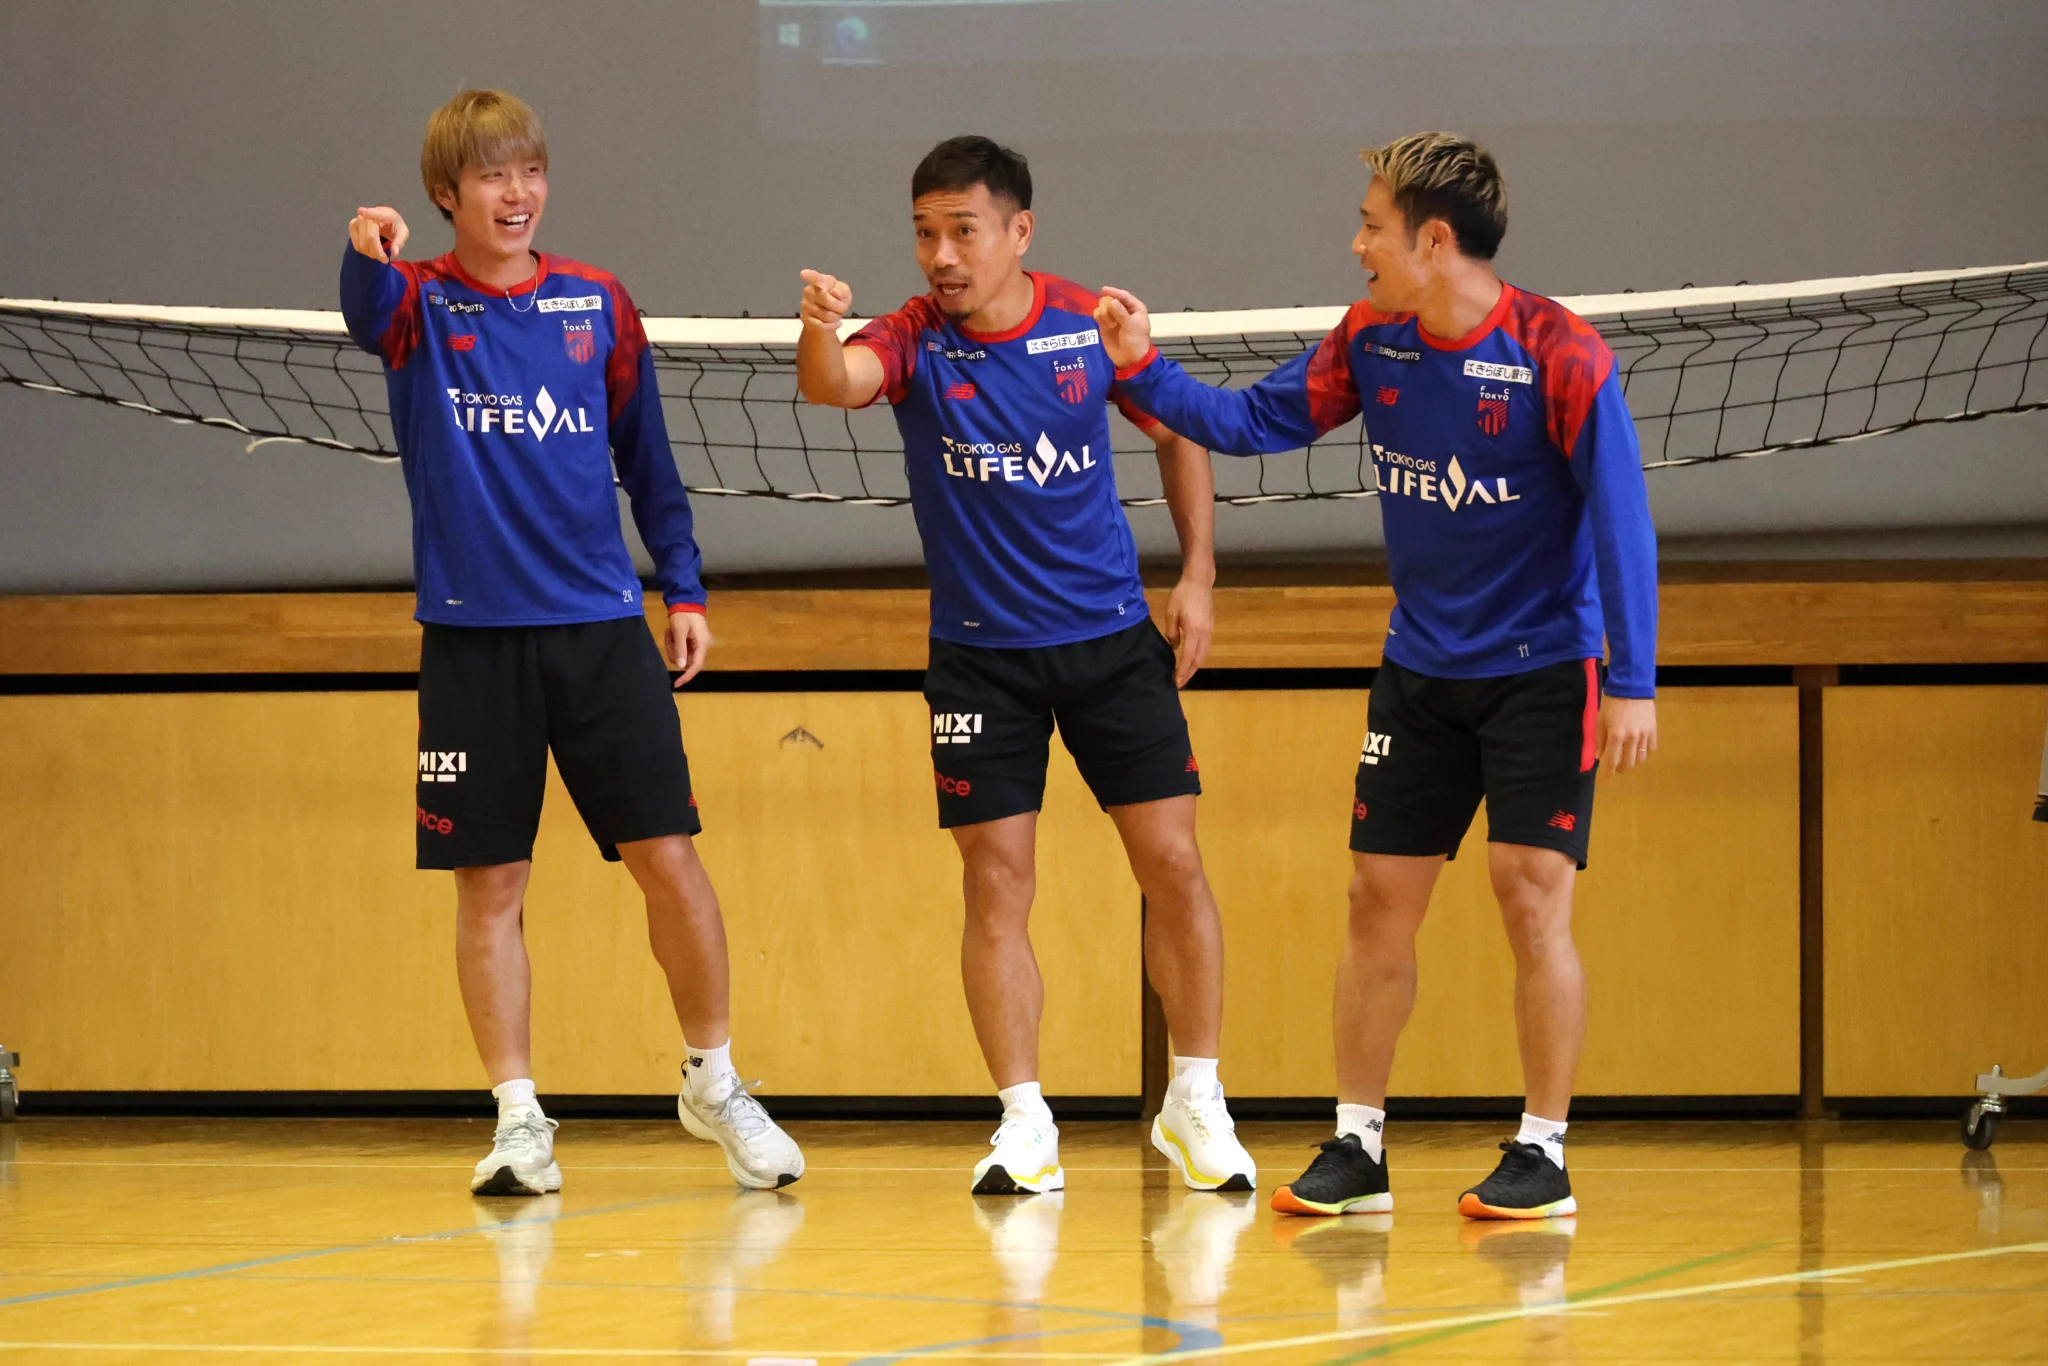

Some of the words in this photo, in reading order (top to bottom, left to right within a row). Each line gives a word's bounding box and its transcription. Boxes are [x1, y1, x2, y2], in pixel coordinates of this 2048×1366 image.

[550, 297, 601, 310] きらぼし銀行
[1041, 332, 1096, 350] きらぼし銀行
[1054, 363, 1085, 372] TOKYO
[1476, 365, 1532, 382] きらぼし銀行
[462, 394, 497, 405] TOKYO
[500, 395, 523, 406] GAS
[1480, 393, 1509, 401] TOKYO
[956, 443, 995, 455] TOKYO
[997, 443, 1022, 454] GAS
[1385, 451, 1414, 469] TOKYO
[1416, 459, 1436, 473] GAS
[622, 590, 633, 603] 28
[1117, 603, 1125, 615] 5
[1517, 644, 1530, 658] 11
[933, 713, 983, 734] MIXI
[419, 751, 467, 772] MIXI
